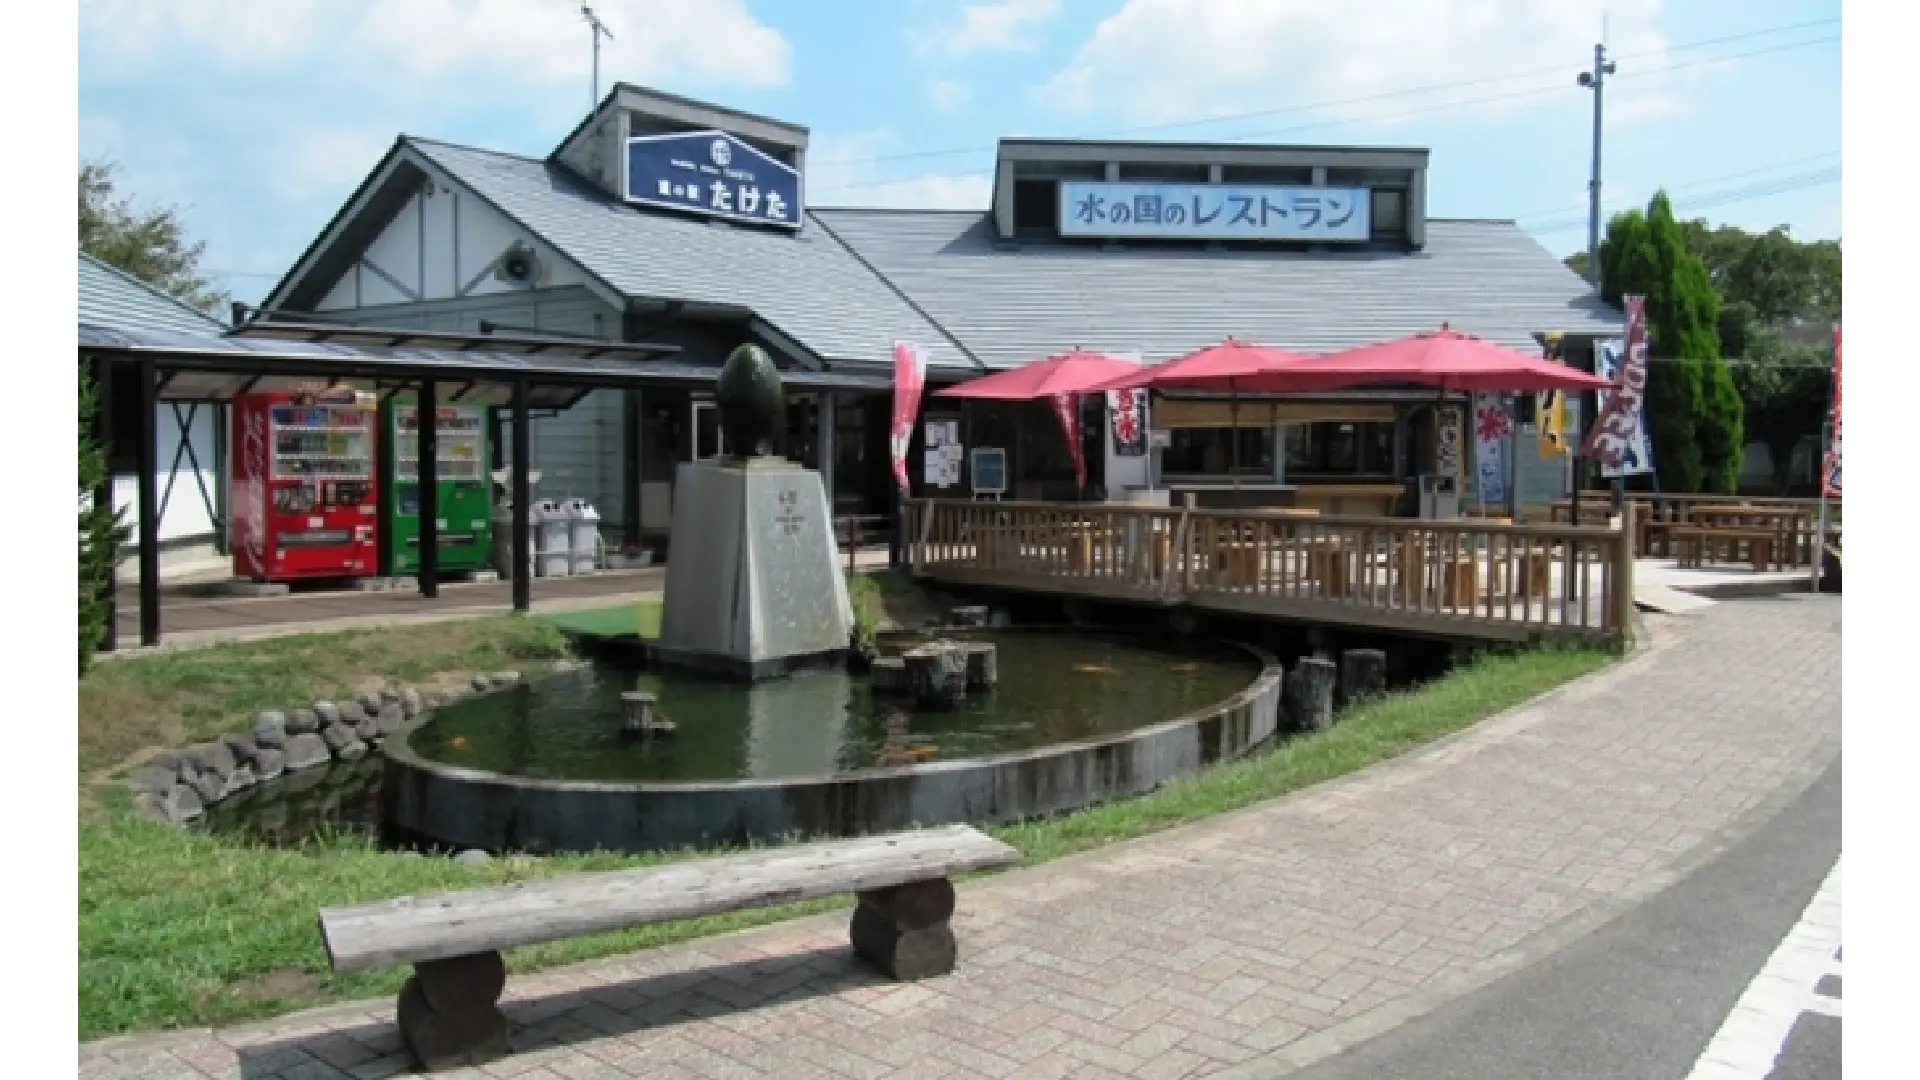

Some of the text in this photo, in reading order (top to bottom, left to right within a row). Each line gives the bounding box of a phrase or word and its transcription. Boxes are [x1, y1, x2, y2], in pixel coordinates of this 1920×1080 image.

[711, 181, 788, 218] たけた
[1075, 193, 1354, 229] 水の国のレストラン
